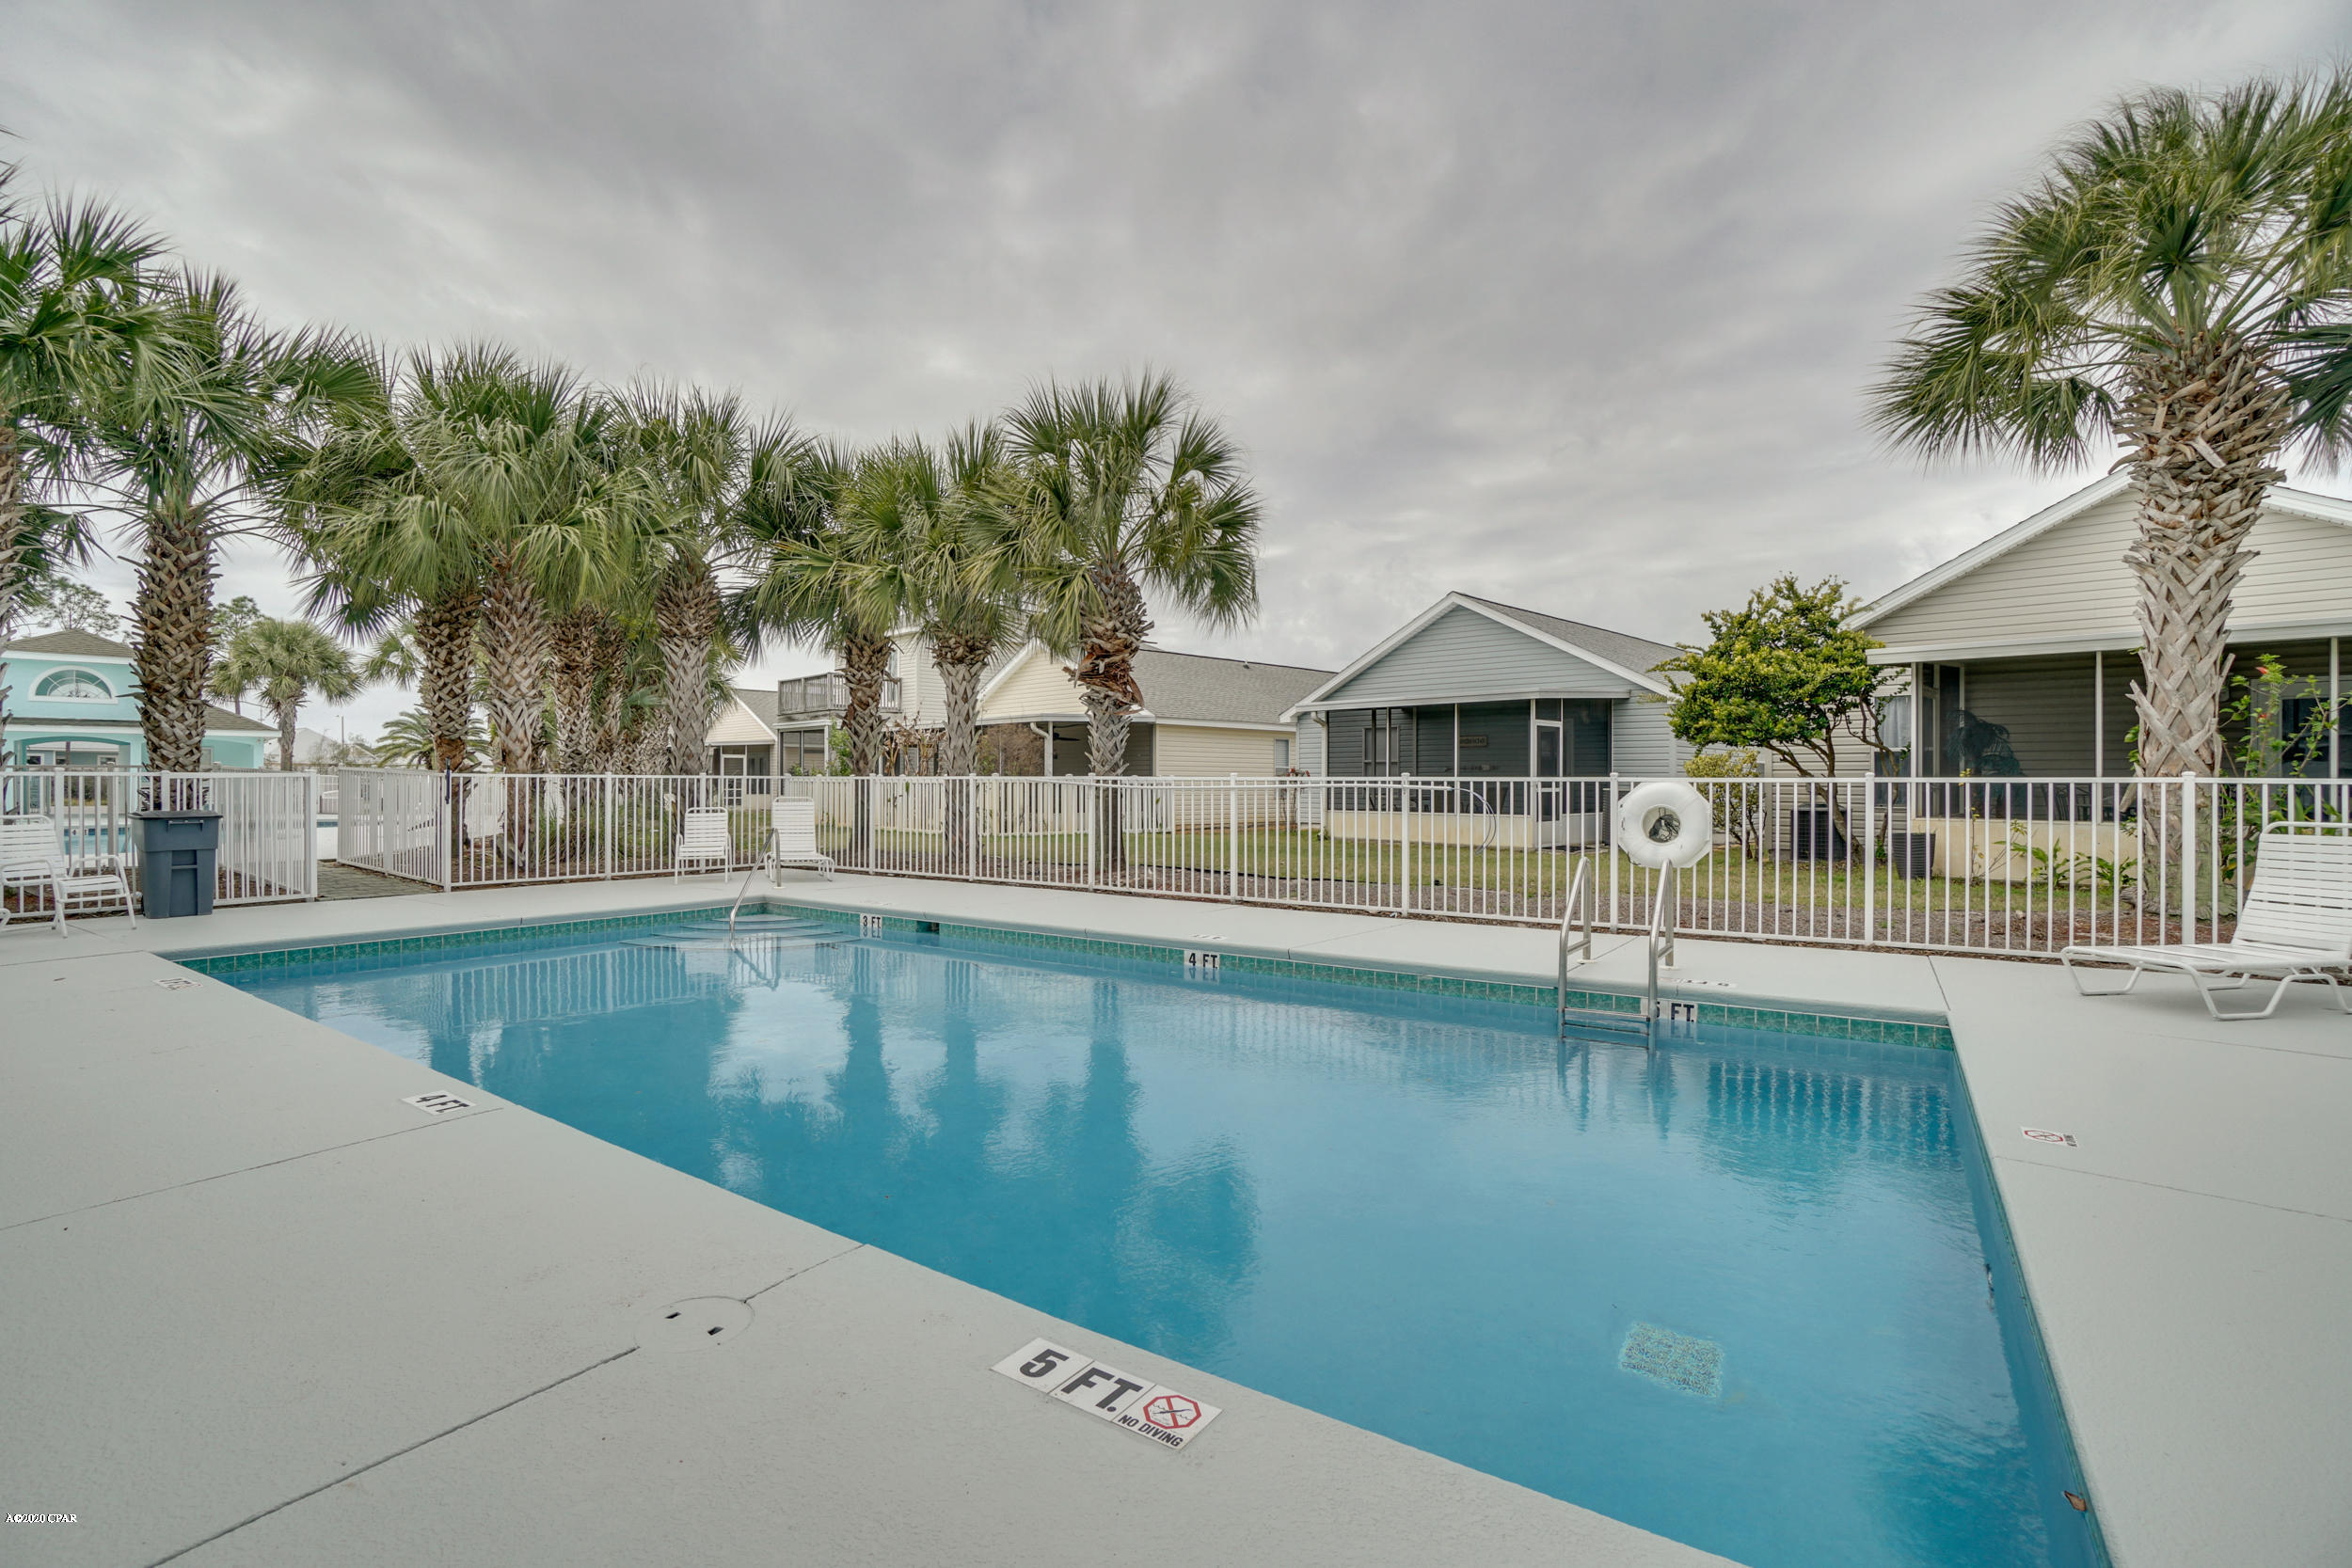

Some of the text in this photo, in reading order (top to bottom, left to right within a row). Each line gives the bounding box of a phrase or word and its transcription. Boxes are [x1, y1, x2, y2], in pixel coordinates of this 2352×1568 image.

[863, 915, 868, 927] 3
[1188, 952, 1197, 966] 4
[1019, 1348, 1070, 1378] 5
[1118, 1414, 1184, 1448] NO DIVING
